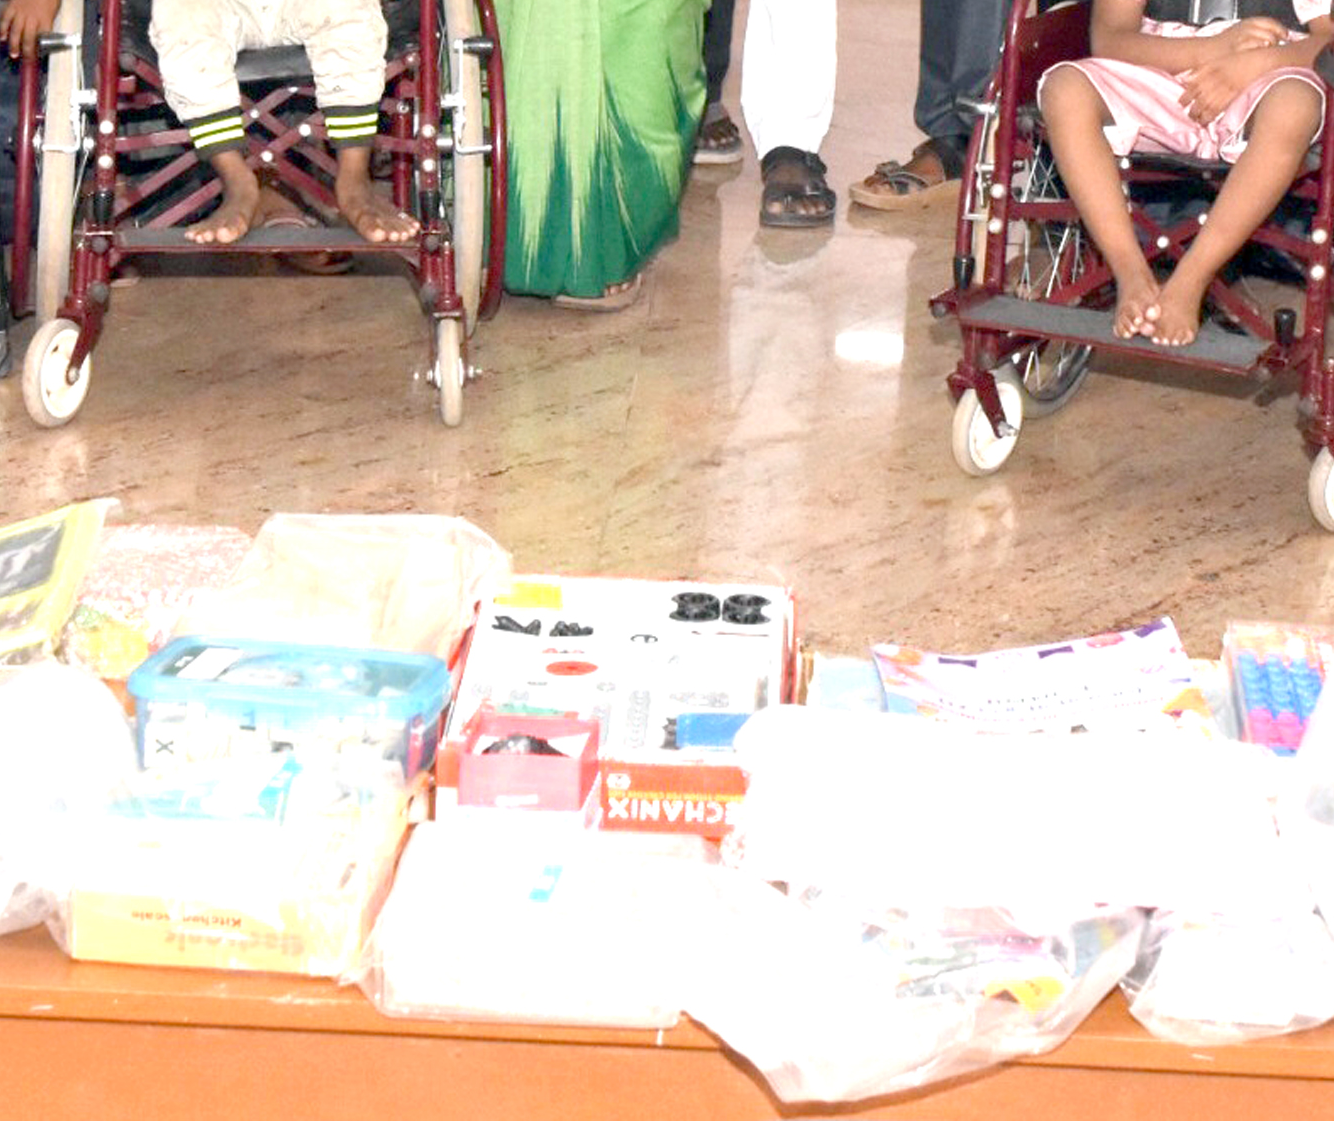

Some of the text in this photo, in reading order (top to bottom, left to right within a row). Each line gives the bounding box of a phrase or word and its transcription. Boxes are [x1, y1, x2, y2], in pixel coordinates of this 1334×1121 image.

[608, 797, 735, 825] ECHANIX
[131, 910, 242, 929] Kitchen scale
